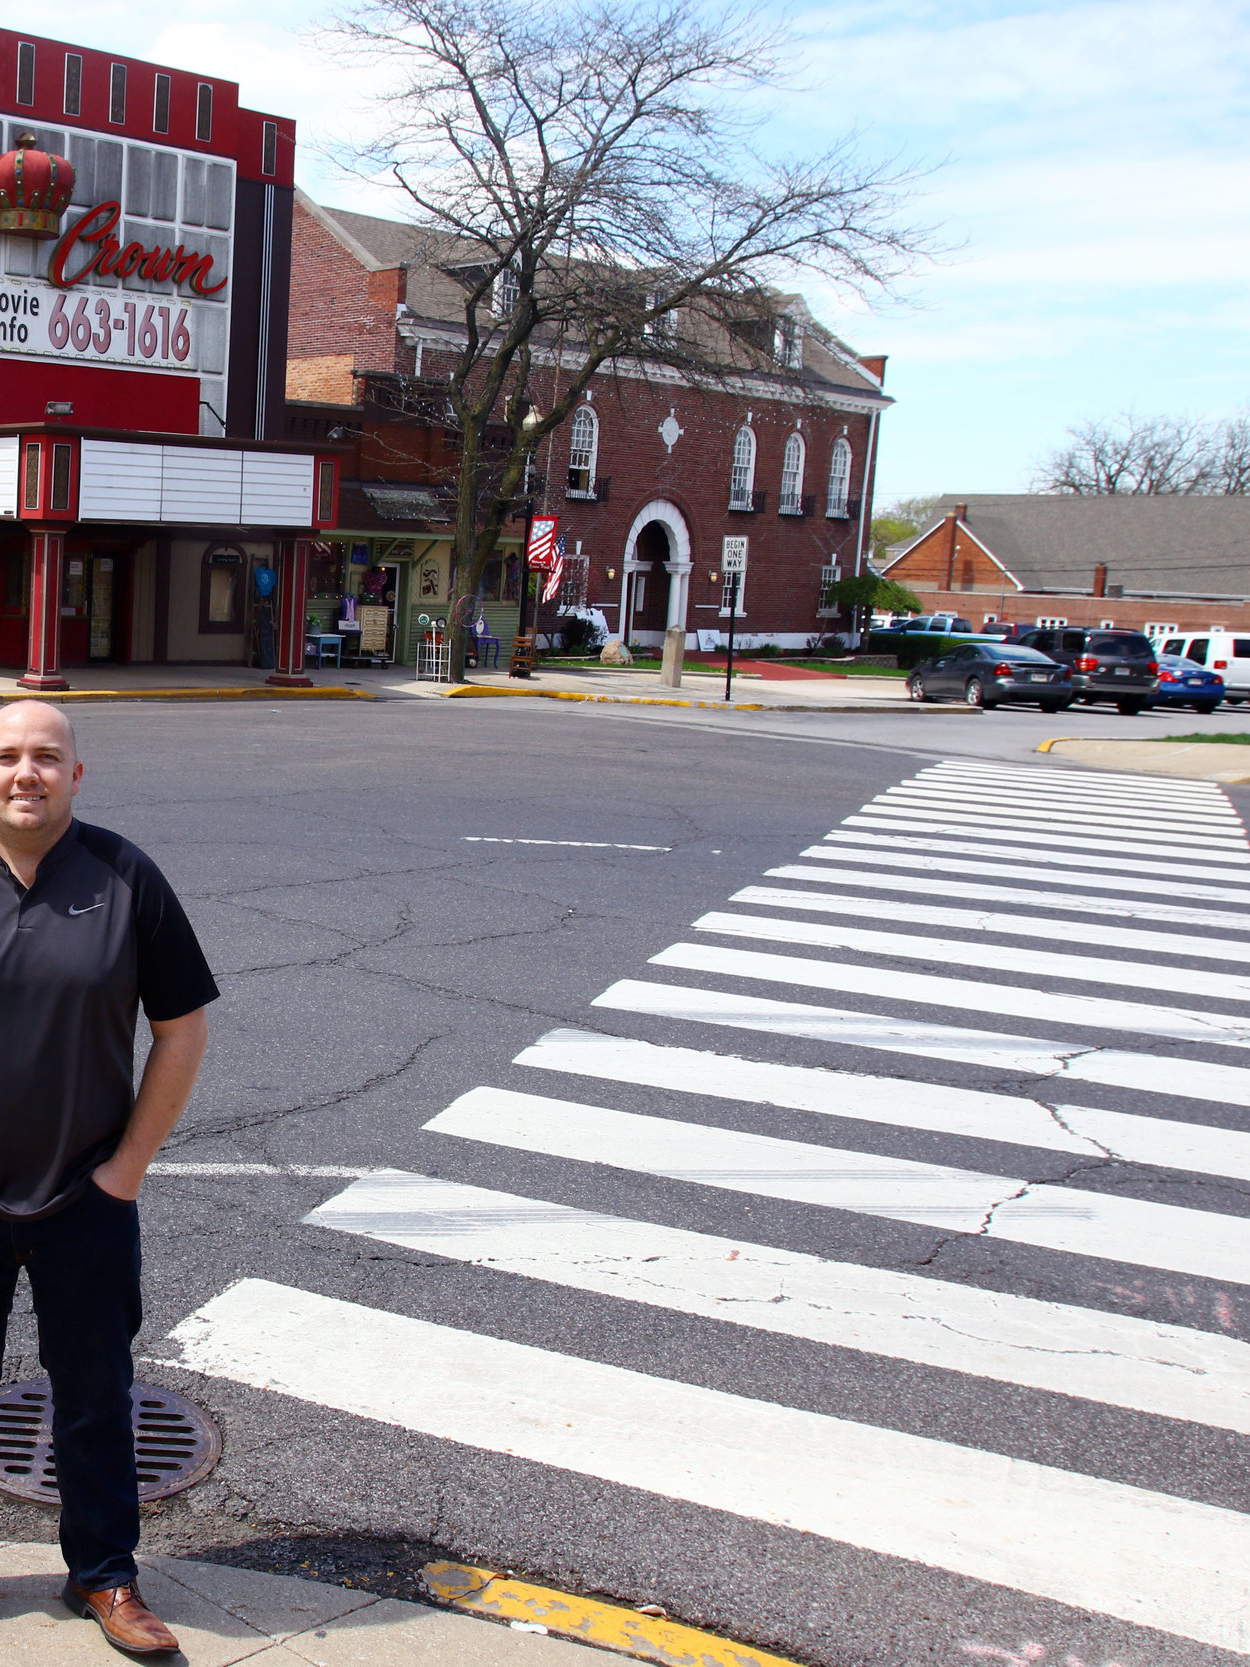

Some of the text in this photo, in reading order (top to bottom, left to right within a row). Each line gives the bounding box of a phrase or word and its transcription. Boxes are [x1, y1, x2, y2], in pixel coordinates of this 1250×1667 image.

[49, 200, 228, 294] Crown
[48, 293, 191, 362] 663-1616
[726, 540, 745, 549] BEGIN
[727, 550, 743, 558] ONE
[727, 559, 742, 567] WAY
